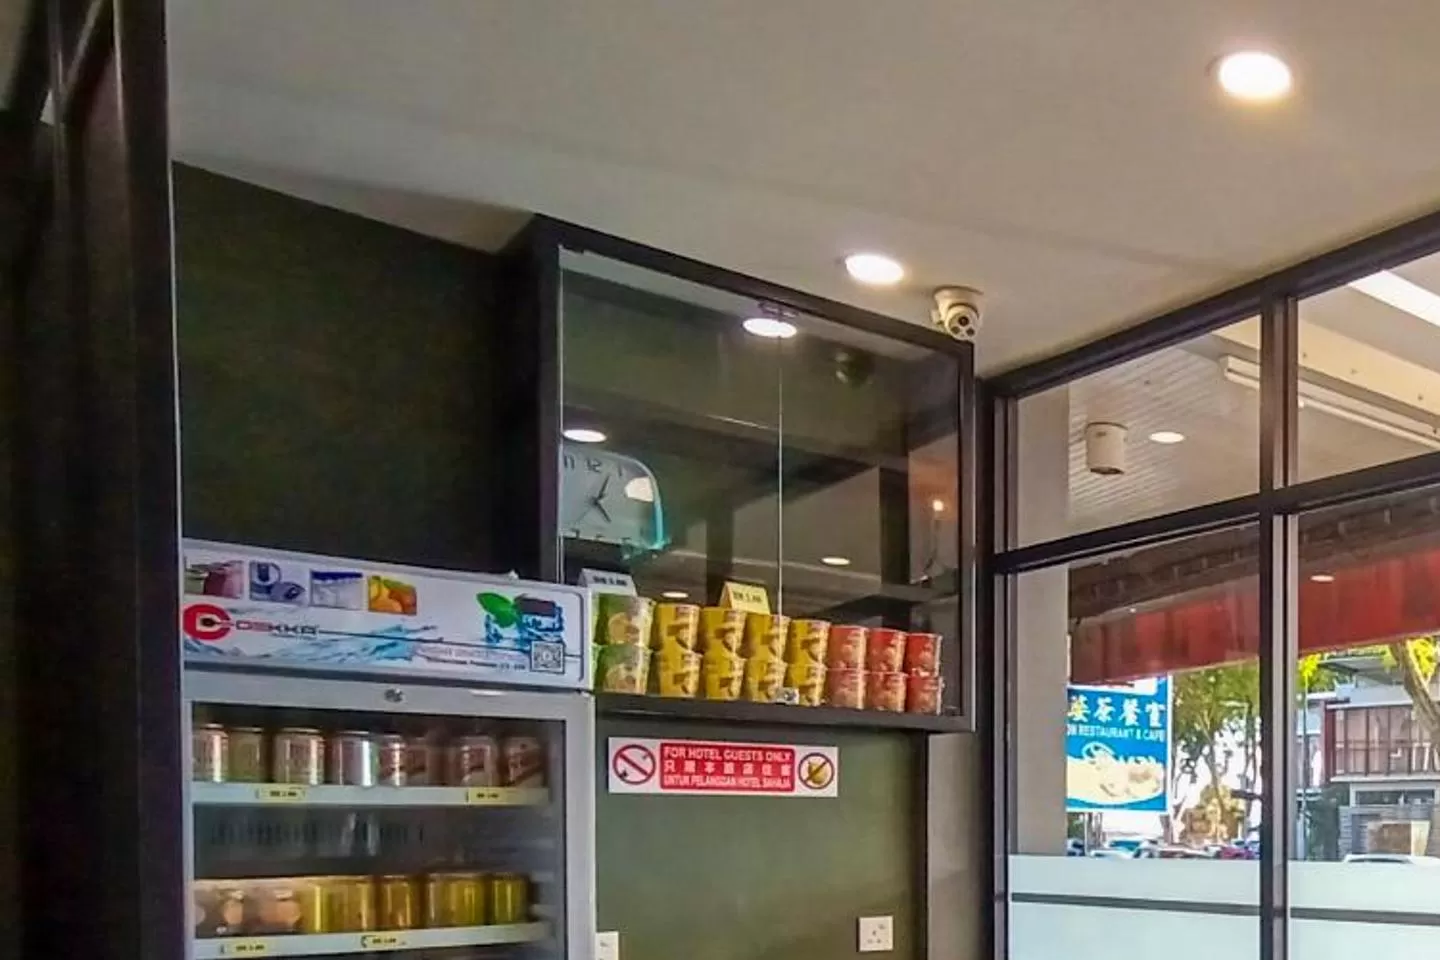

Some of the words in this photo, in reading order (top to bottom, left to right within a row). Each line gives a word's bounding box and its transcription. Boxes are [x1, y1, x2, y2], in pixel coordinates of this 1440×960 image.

[1079, 724, 1134, 739] RESTAURANT
[664, 746, 686, 759] FOR
[688, 748, 722, 761] HOTEL
[724, 749, 763, 762] GUESTS
[765, 751, 791, 763] ONLY
